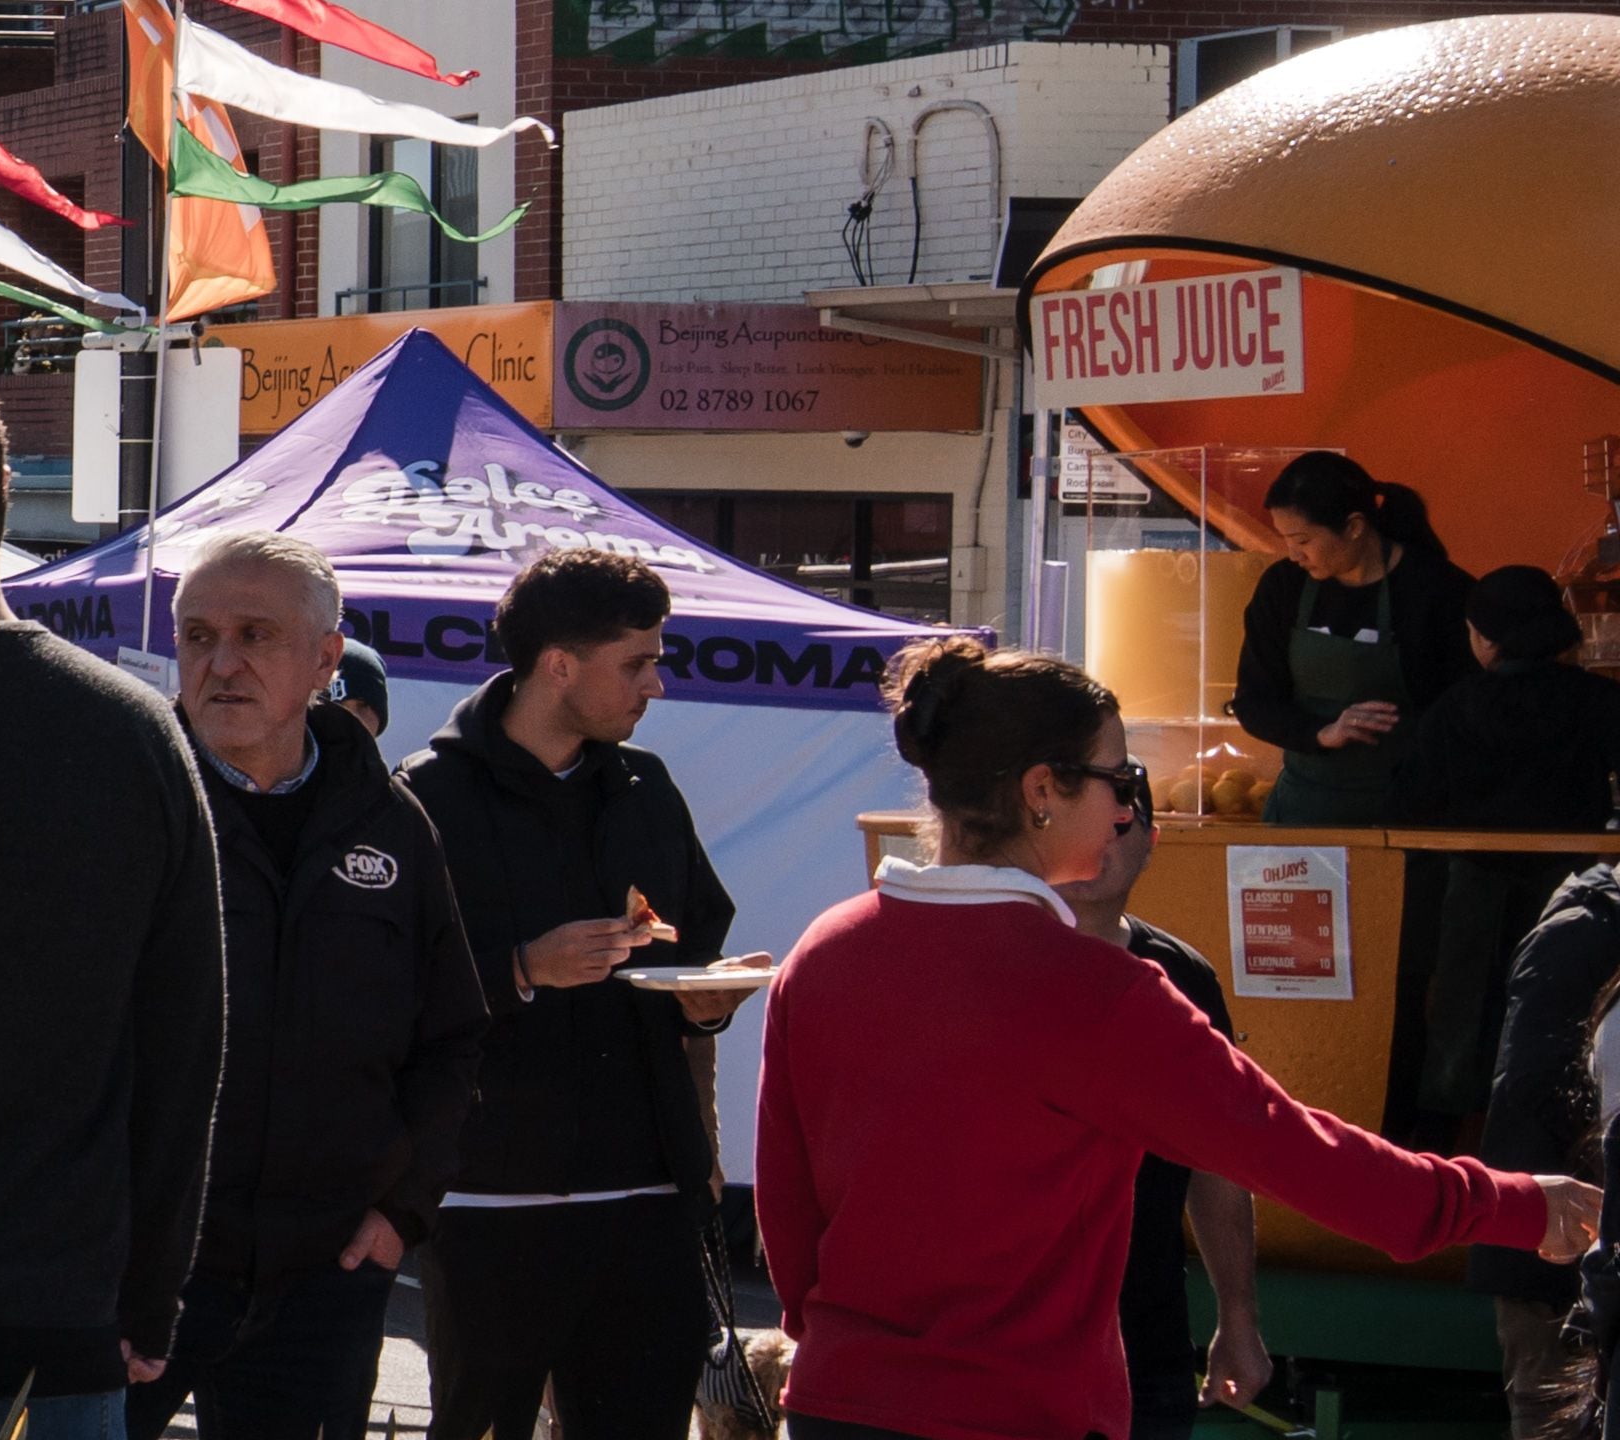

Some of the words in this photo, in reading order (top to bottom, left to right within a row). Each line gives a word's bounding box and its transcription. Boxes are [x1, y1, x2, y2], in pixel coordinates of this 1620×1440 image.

[659, 320, 737, 354] Beijing
[733, 321, 854, 354] Acupuncture
[1042, 288, 1161, 382] FRESH
[1172, 276, 1285, 372] JUICE
[241, 347, 312, 420] Beijing
[660, 389, 689, 412] 02
[696, 389, 754, 412] 8789
[764, 389, 820, 413] 1067
[1068, 429, 1087, 440] City
[660, 632, 886, 690] ROMA
[344, 852, 389, 876] FOX
[1244, 891, 1282, 904] CLASSIC
[1317, 893, 1328, 905] 10
[1318, 926, 1330, 937] 10
[1247, 956, 1296, 969] LEMONADE
[1320, 958, 1331, 970] 10
